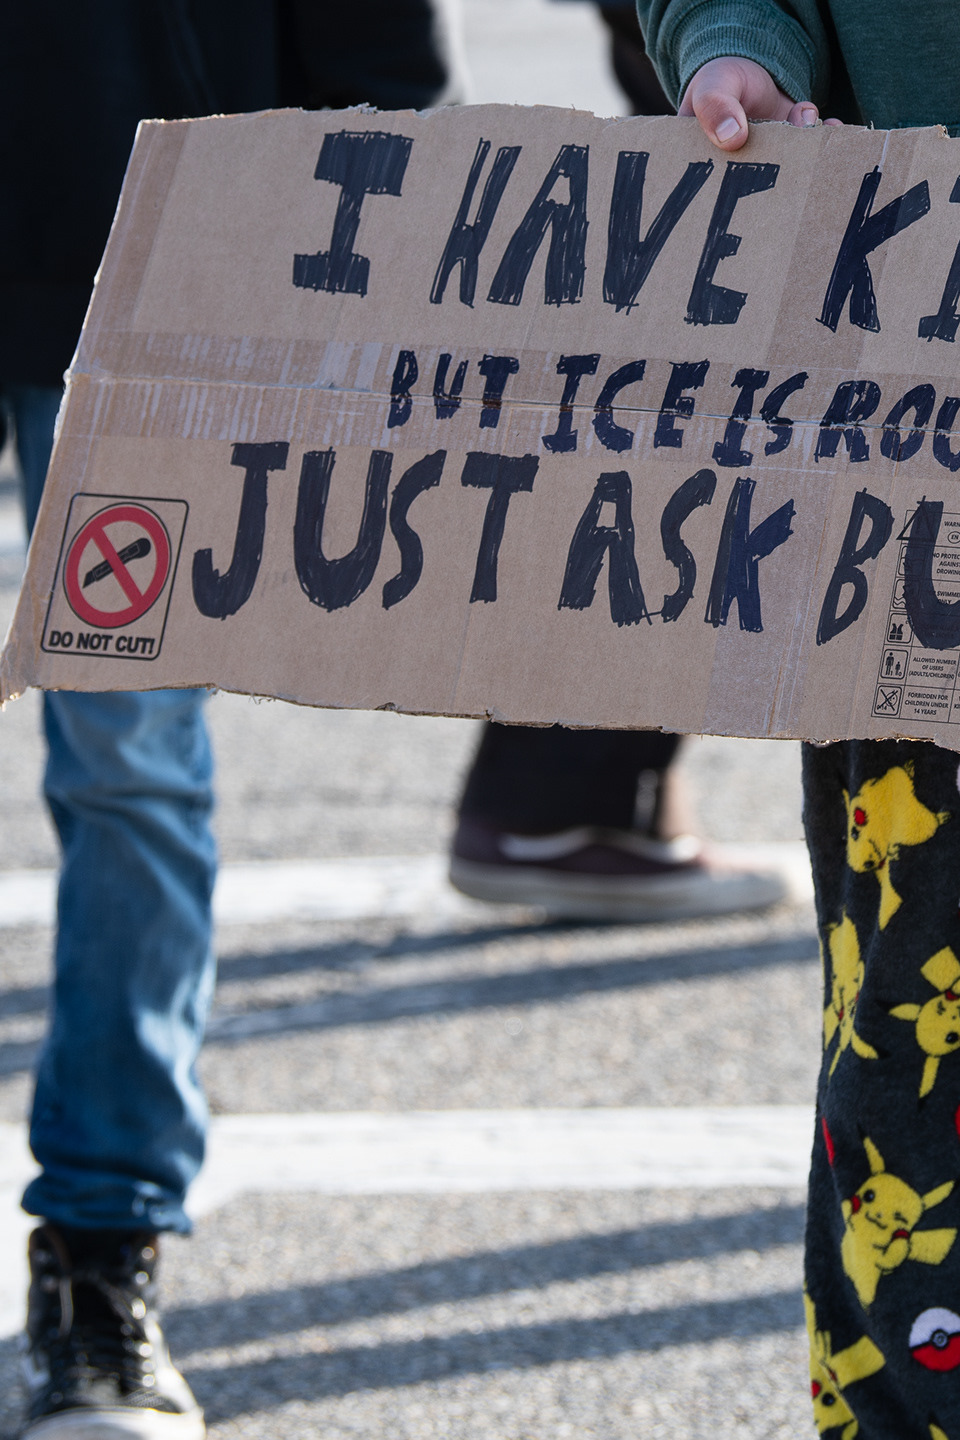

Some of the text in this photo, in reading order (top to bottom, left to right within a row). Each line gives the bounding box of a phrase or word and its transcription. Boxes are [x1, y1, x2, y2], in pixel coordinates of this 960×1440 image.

[293, 130, 415, 297] I
[430, 137, 780, 326] HAVE
[387, 350, 519, 429] BUT
[543, 353, 711, 453] ICE
[713, 368, 809, 468] IS
[191, 441, 541, 621] JUST
[557, 469, 796, 634] ASK
[48, 630, 156, 655] DO NOT CUT!
